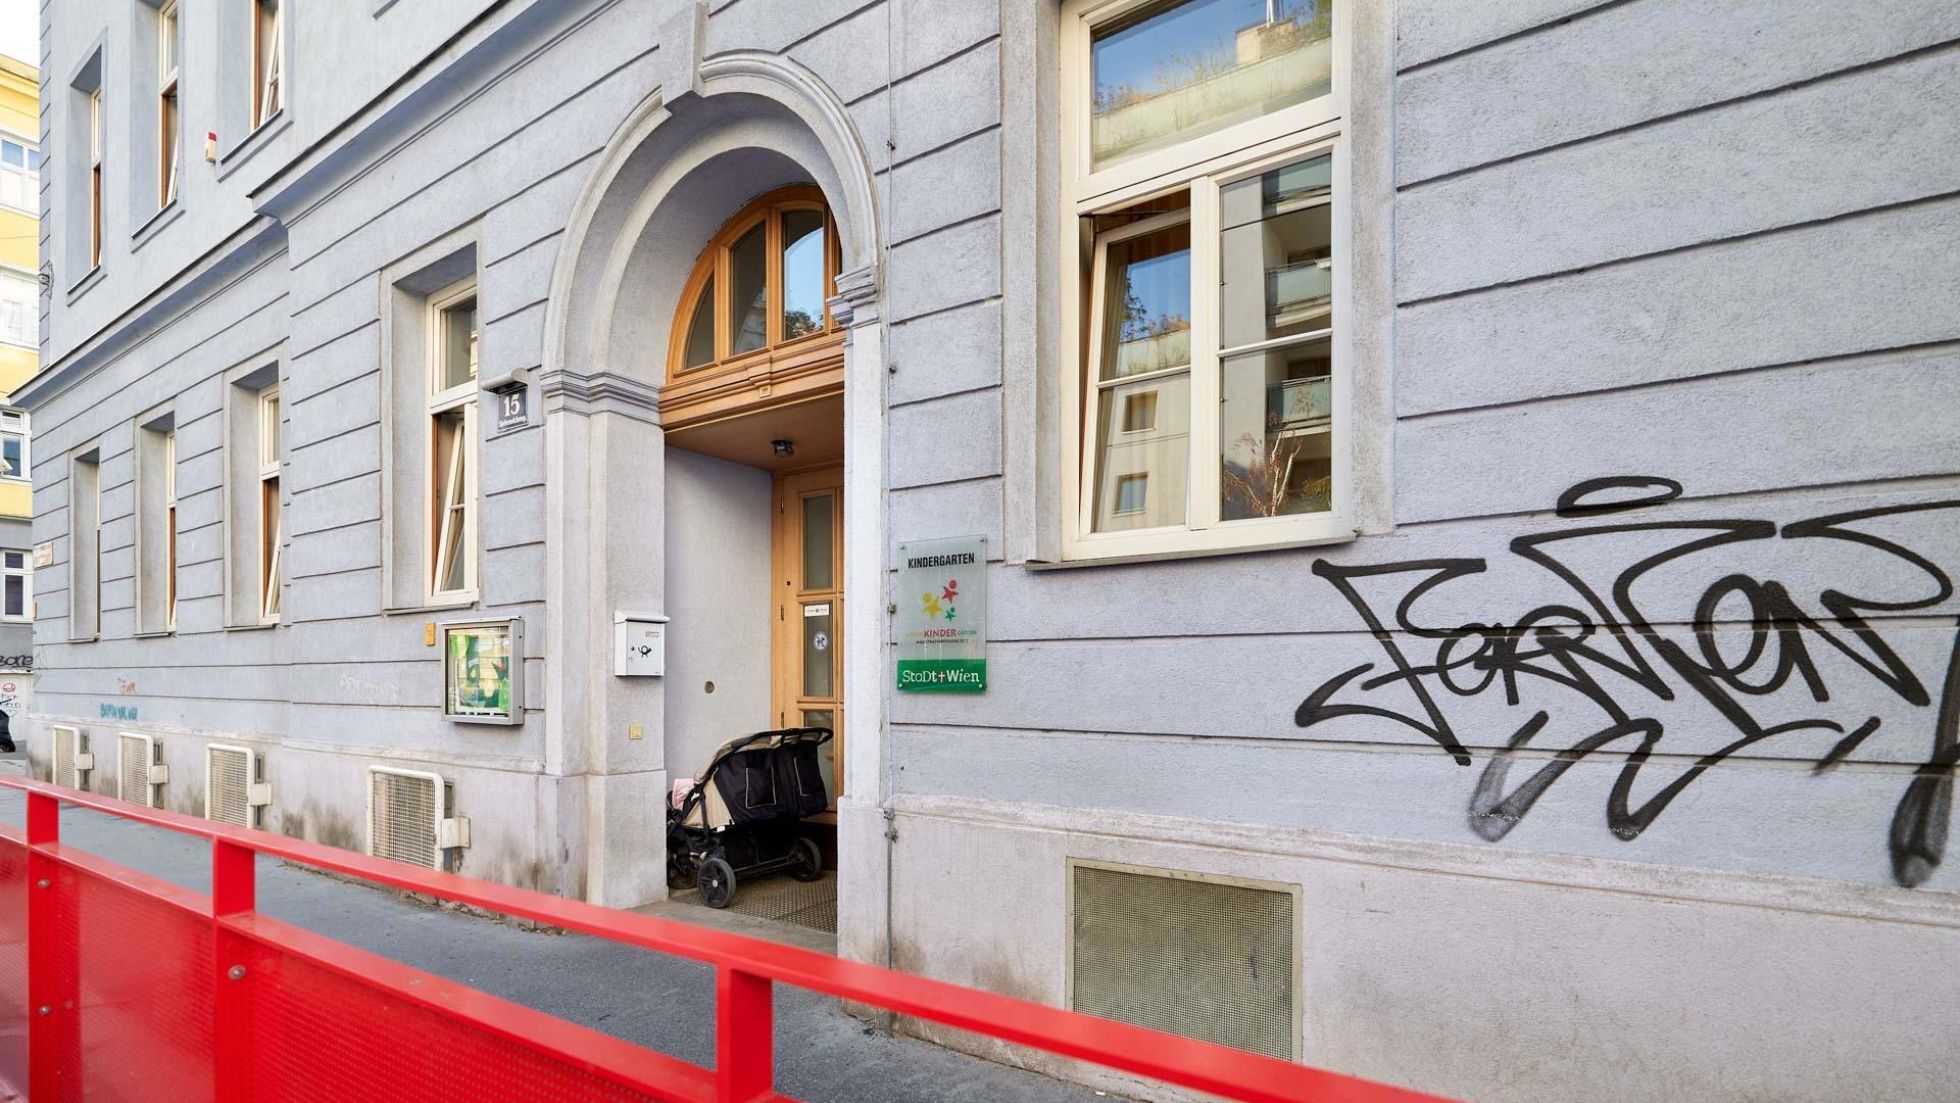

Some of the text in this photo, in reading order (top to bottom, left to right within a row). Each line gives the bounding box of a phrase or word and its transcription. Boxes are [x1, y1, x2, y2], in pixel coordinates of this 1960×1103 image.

[504, 393, 520, 416] 15
[908, 552, 975, 569] KINDERGARTEN
[923, 629, 957, 638] KINDER
[945, 668, 980, 682] Wien
